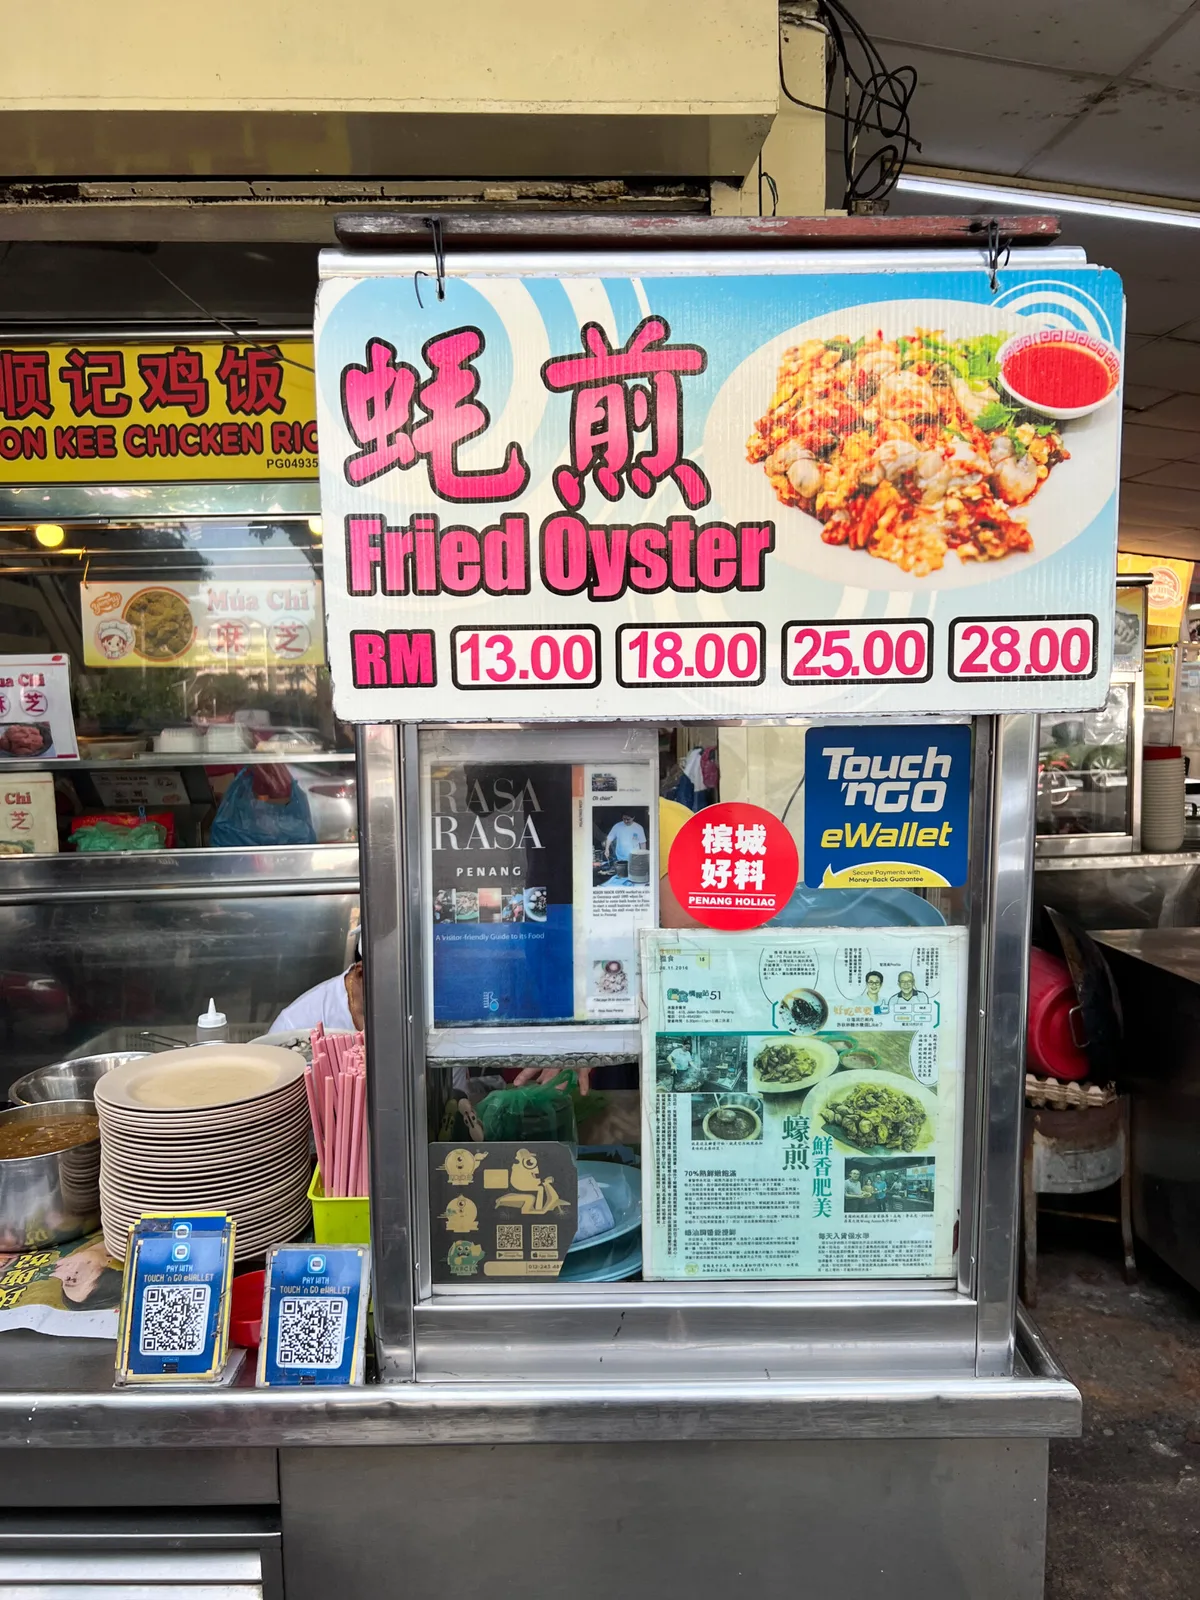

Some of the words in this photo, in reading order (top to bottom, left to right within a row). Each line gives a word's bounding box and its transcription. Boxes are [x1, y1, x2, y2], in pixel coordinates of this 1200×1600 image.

[0, 345, 286, 420] 顺记鸡饭
[340, 315, 711, 512] 蚝煎
[54, 425, 117, 459] KEE
[123, 422, 264, 458] CHICKEN
[266, 458, 318, 469] PG04935
[344, 512, 531, 596] Fried
[540, 511, 775, 601] Oyster
[266, 587, 309, 611] Chi
[350, 628, 438, 688] RM
[460, 633, 593, 681] 13.00
[628, 631, 758, 680] 18.00
[792, 628, 925, 677] 25.00
[960, 625, 1090, 675] 28.00
[822, 746, 952, 780] Touch
[4, 791, 32, 805] Chi
[432, 778, 545, 814] RASA
[9, 810, 30, 830] 芝
[432, 814, 546, 851] RASA
[820, 821, 953, 848] eWallet
[456, 866, 521, 877] PENANG
[700, 858, 766, 891] 好料
[848, 876, 888, 884] Money-Back
[688, 896, 732, 905] PENANG
[735, 897, 776, 907] HOLIAO
[519, 932, 527, 940] its
[528, 932, 545, 940] Food
[709, 989, 722, 1001] 51
[781, 1115, 811, 1171] 蠔煎
[812, 1135, 833, 1219] 鮮香肥美
[144, 1274, 164, 1282] TOUCH
[173, 1274, 182, 1282] GO
[183, 1273, 214, 1282] eWALLET
[166, 1264, 178, 1272] PAY
[180, 1264, 193, 1272] WITH
[302, 1276, 315, 1284] PAY
[315, 1276, 330, 1284] WITH
[280, 1286, 300, 1294] TOUCH
[310, 1286, 318, 1294] GO
[320, 1286, 351, 1295] eWALLET
